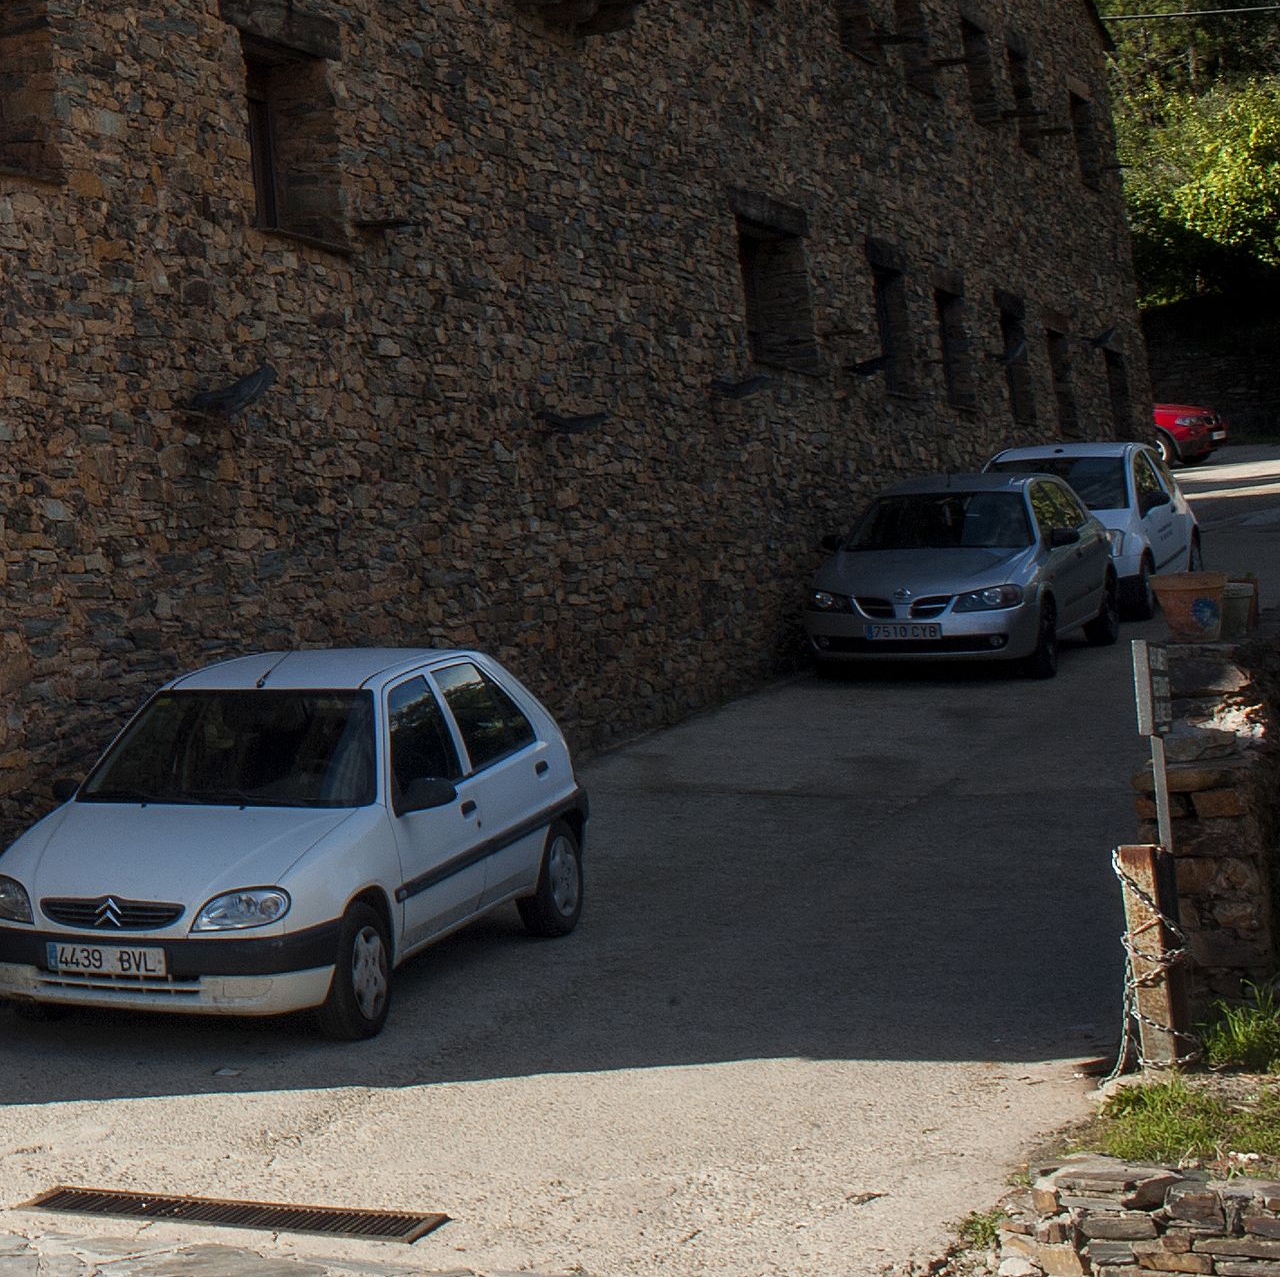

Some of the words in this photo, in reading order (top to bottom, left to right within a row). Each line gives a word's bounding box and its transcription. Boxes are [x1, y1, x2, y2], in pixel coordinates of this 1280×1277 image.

[911, 625, 938, 638] CYB
[58, 945, 103, 970] 4439
[118, 949, 157, 973] BVL
